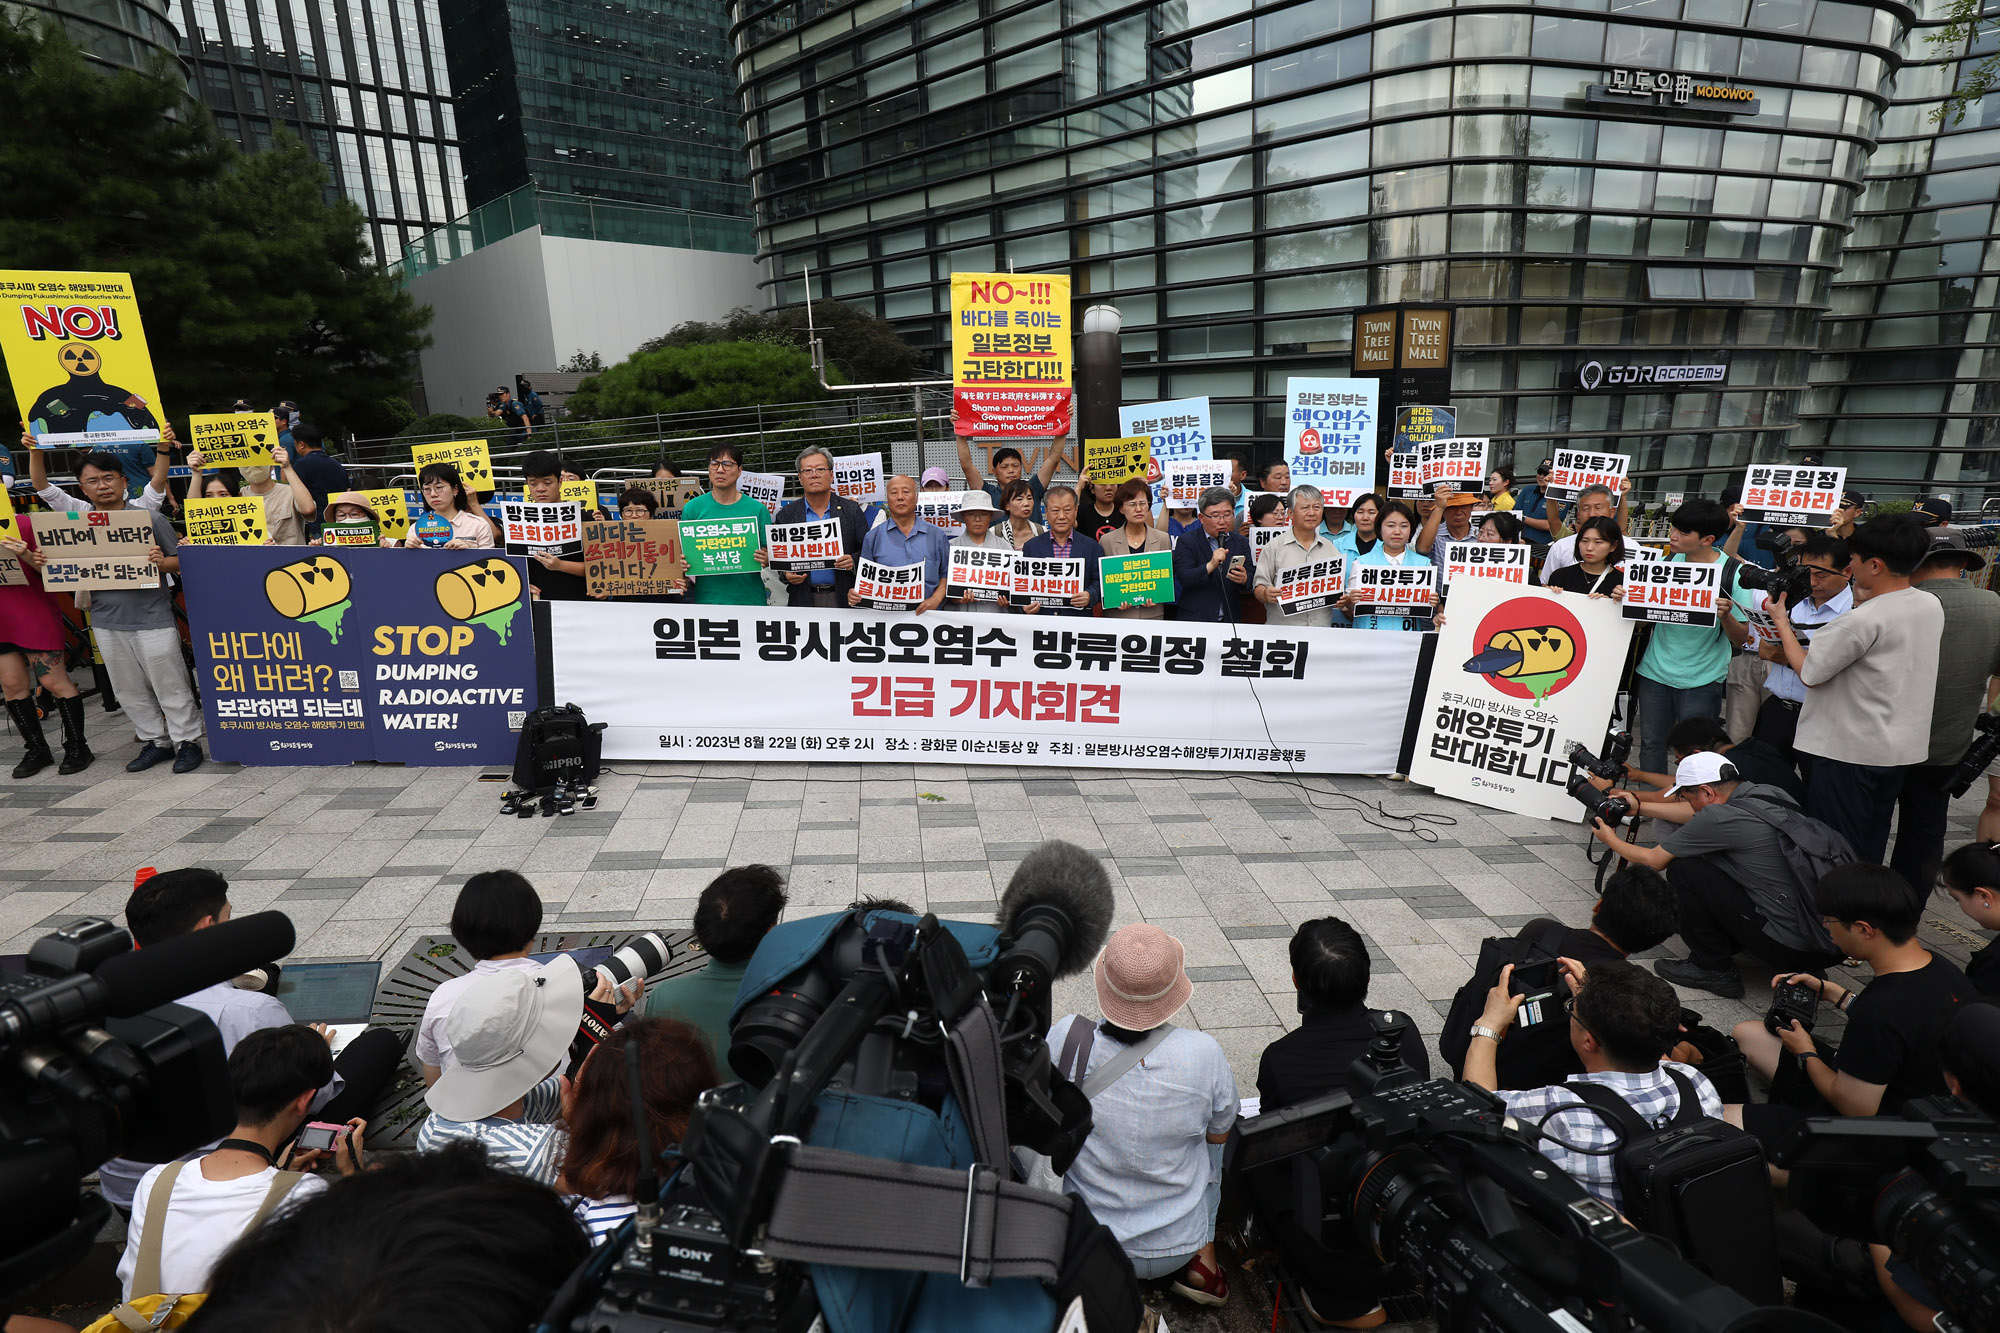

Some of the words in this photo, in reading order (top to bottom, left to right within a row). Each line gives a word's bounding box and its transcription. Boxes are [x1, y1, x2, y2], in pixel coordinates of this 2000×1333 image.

[1696, 85, 1755, 101] MODOWOO
[38, 283, 66, 292] 오염수
[68, 283, 124, 293] 해양투기반대
[971, 281, 1050, 305] NO~!!!
[20, 304, 122, 341] NO!
[961, 310, 1008, 327] 바다를
[1014, 311, 1061, 328] 죽이는
[1364, 321, 1391, 334] TWIN
[1410, 317, 1441, 331] TWIN
[972, 333, 1052, 354] 일본정부
[1363, 335, 1390, 348] TREE
[1410, 332, 1440, 345] TREE
[1362, 349, 1389, 362] MALL
[1408, 347, 1439, 360] MALL
[962, 360, 1063, 381] 규탄한다!!!
[1608, 366, 1654, 383] GDR
[1657, 367, 1724, 380] ACADEMY
[971, 404, 1000, 412] Shame
[1014, 404, 1055, 413] Japanese
[1297, 392, 1325, 406] 일본
[1327, 393, 1368, 407] 정부는
[981, 413, 1032, 421] Government
[1034, 413, 1046, 421] for
[1291, 408, 1372, 431] 핵오염수
[1411, 407, 1433, 415] 바다는
[194, 422, 235, 435] 후쿠시마
[237, 419, 269, 431] 오염수
[973, 423, 999, 432] Killing
[1131, 418, 1158, 434] 일본
[1160, 415, 1200, 431] 정부는
[1408, 425, 1445, 433] 쓰레기통이
[198, 434, 247, 450] 해양투기
[1088, 445, 1121, 457] 후쿠시마
[1122, 441, 1147, 452] 오염수
[1150, 431, 1207, 457] 오염수
[1322, 433, 1362, 455] 방류
[203, 450, 224, 464] 절대
[226, 449, 251, 461] 안돼!
[417, 452, 452, 464] 후쿠시마
[454, 445, 482, 458] 오염수
[1421, 442, 1483, 462] 방류일정
[1089, 455, 1127, 469] 해양투기
[1422, 460, 1482, 480] 철회하라
[1557, 451, 1624, 474] 해양투기
[1089, 470, 1106, 480] 절대
[1107, 469, 1127, 479] 안돼!
[1172, 473, 1224, 486] 방류결정
[1553, 470, 1620, 492] 결사반대
[1751, 467, 1839, 490] 방류일정
[371, 494, 399, 506] 오염수
[563, 486, 590, 497] 오염수
[1746, 487, 1835, 511] 철회하라
[87, 511, 110, 527] 왜
[188, 506, 224, 520] 후쿠시마
[226, 502, 258, 515] 오염수
[505, 505, 576, 524] 방류일정
[37, 526, 98, 547] 바다에
[106, 525, 153, 545] 버려?
[190, 519, 237, 536] 해양투기
[508, 523, 578, 542] 철회하라
[586, 522, 646, 542] 바다는
[682, 525, 695, 537] 핵
[696, 524, 731, 537] 오염수
[731, 522, 755, 535] 투기
[770, 522, 838, 543] 해양투기
[584, 539, 675, 563] 쓰레기통이
[696, 536, 747, 550] 규탄한다!
[772, 540, 840, 559] 결사반대
[703, 550, 741, 565] 녹색당
[1122, 558, 1150, 571] 일본의
[1450, 546, 1525, 565] 해양투기
[47, 562, 110, 584] 보관하면
[114, 563, 158, 581] 되는데!
[589, 561, 658, 580] 아니다!
[861, 562, 922, 584] 해양투기
[1014, 559, 1080, 580] 해양투기
[1105, 571, 1142, 585] 해양투기
[1143, 568, 1170, 581] 결정을
[1281, 558, 1343, 584] 방류일정
[1361, 568, 1432, 586] 해양투기
[1629, 563, 1716, 587] 해양투기
[606, 581, 635, 594] 후쿠시마
[636, 581, 655, 594] 오염수
[656, 580, 673, 593] 방류
[858, 580, 922, 600] 결사반대
[1014, 577, 1079, 595] 결사반대
[1120, 581, 1157, 594] 규탄한다
[1280, 577, 1342, 601] 철회하라
[1359, 587, 1430, 604] 결사반대
[1627, 584, 1713, 608] 결사반대
[208, 631, 304, 661] 바다에
[372, 625, 475, 657] STOP
[653, 618, 741, 662] 일본
[756, 620, 1017, 668] 방사성오염수
[1032, 629, 1207, 677] 방류일정
[1220, 637, 1309, 680] 철회
[212, 664, 247, 693] 왜
[253, 664, 334, 693] 버려?
[376, 663, 479, 682] DUMPING
[378, 688, 524, 706] RADIOACTIVE
[850, 675, 935, 718] 긴급
[950, 679, 1121, 724] 기자회견
[216, 698, 299, 718] 보관하면
[303, 698, 364, 718] 되는데
[1441, 691, 1486, 710] 후쿠시마
[1488, 701, 1521, 718] 방사능
[1523, 708, 1559, 725] 오염수
[219, 720, 255, 730] 후쿠시마
[256, 720, 283, 730] 방사능
[284, 720, 311, 730] 오염수
[311, 720, 346, 730] 해양투기
[347, 720, 365, 730] 반대
[382, 712, 458, 730] WATER!
[1435, 705, 1556, 755] 해양투기
[659, 735, 684, 748] 일시
[695, 735, 740, 749] 2023년
[744, 735, 765, 749] 8월
[768, 736, 797, 749] 22일
[800, 735, 822, 751] (화)
[826, 737, 851, 750] 오후
[854, 737, 875, 750] 2시
[885, 737, 910, 752] 장소
[920, 737, 958, 753] 광화문
[962, 739, 1023, 754] 이순신동상
[1027, 741, 1039, 754] 앞
[1049, 742, 1074, 756] 주최
[1085, 743, 1306, 762] 일본방사성오염수해양투기저지공동행동
[1430, 732, 1579, 788] 반대합니다
[582, 1013, 610, 1040] anon
[668, 1245, 713, 1262] SONY
